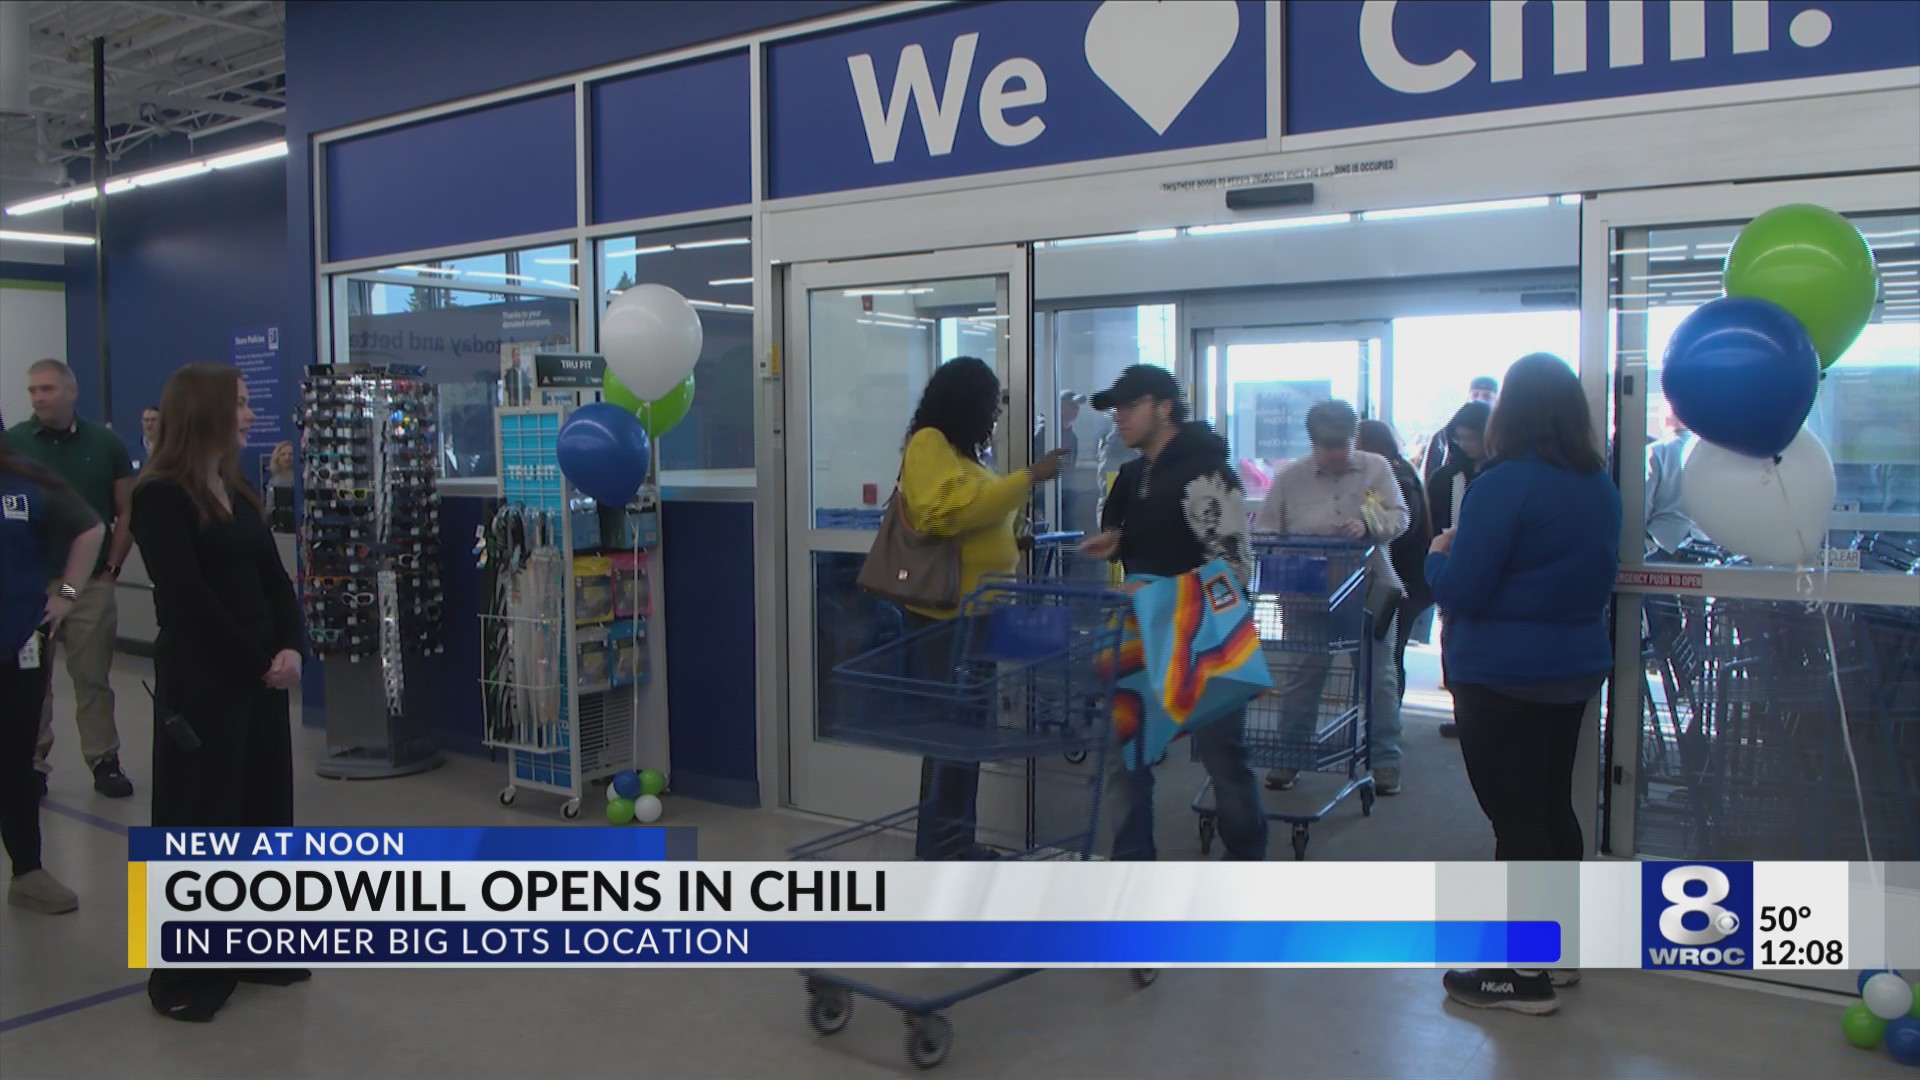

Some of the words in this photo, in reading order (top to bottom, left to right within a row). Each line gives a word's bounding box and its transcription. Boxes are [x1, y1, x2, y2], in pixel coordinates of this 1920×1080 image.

[847, 32, 1048, 164] We
[1351, 162, 1359, 173] IS
[1359, 160, 1394, 172] OCCUPIED
[560, 360, 578, 369] TRU
[580, 360, 592, 369] FIT
[507, 464, 533, 480] TRU
[536, 464, 555, 480] FIT
[1649, 574, 1670, 585] PUSH
[1671, 574, 1681, 586] TO
[1682, 575, 1702, 587] OPEN
[1481, 981, 1514, 994] HOKA
